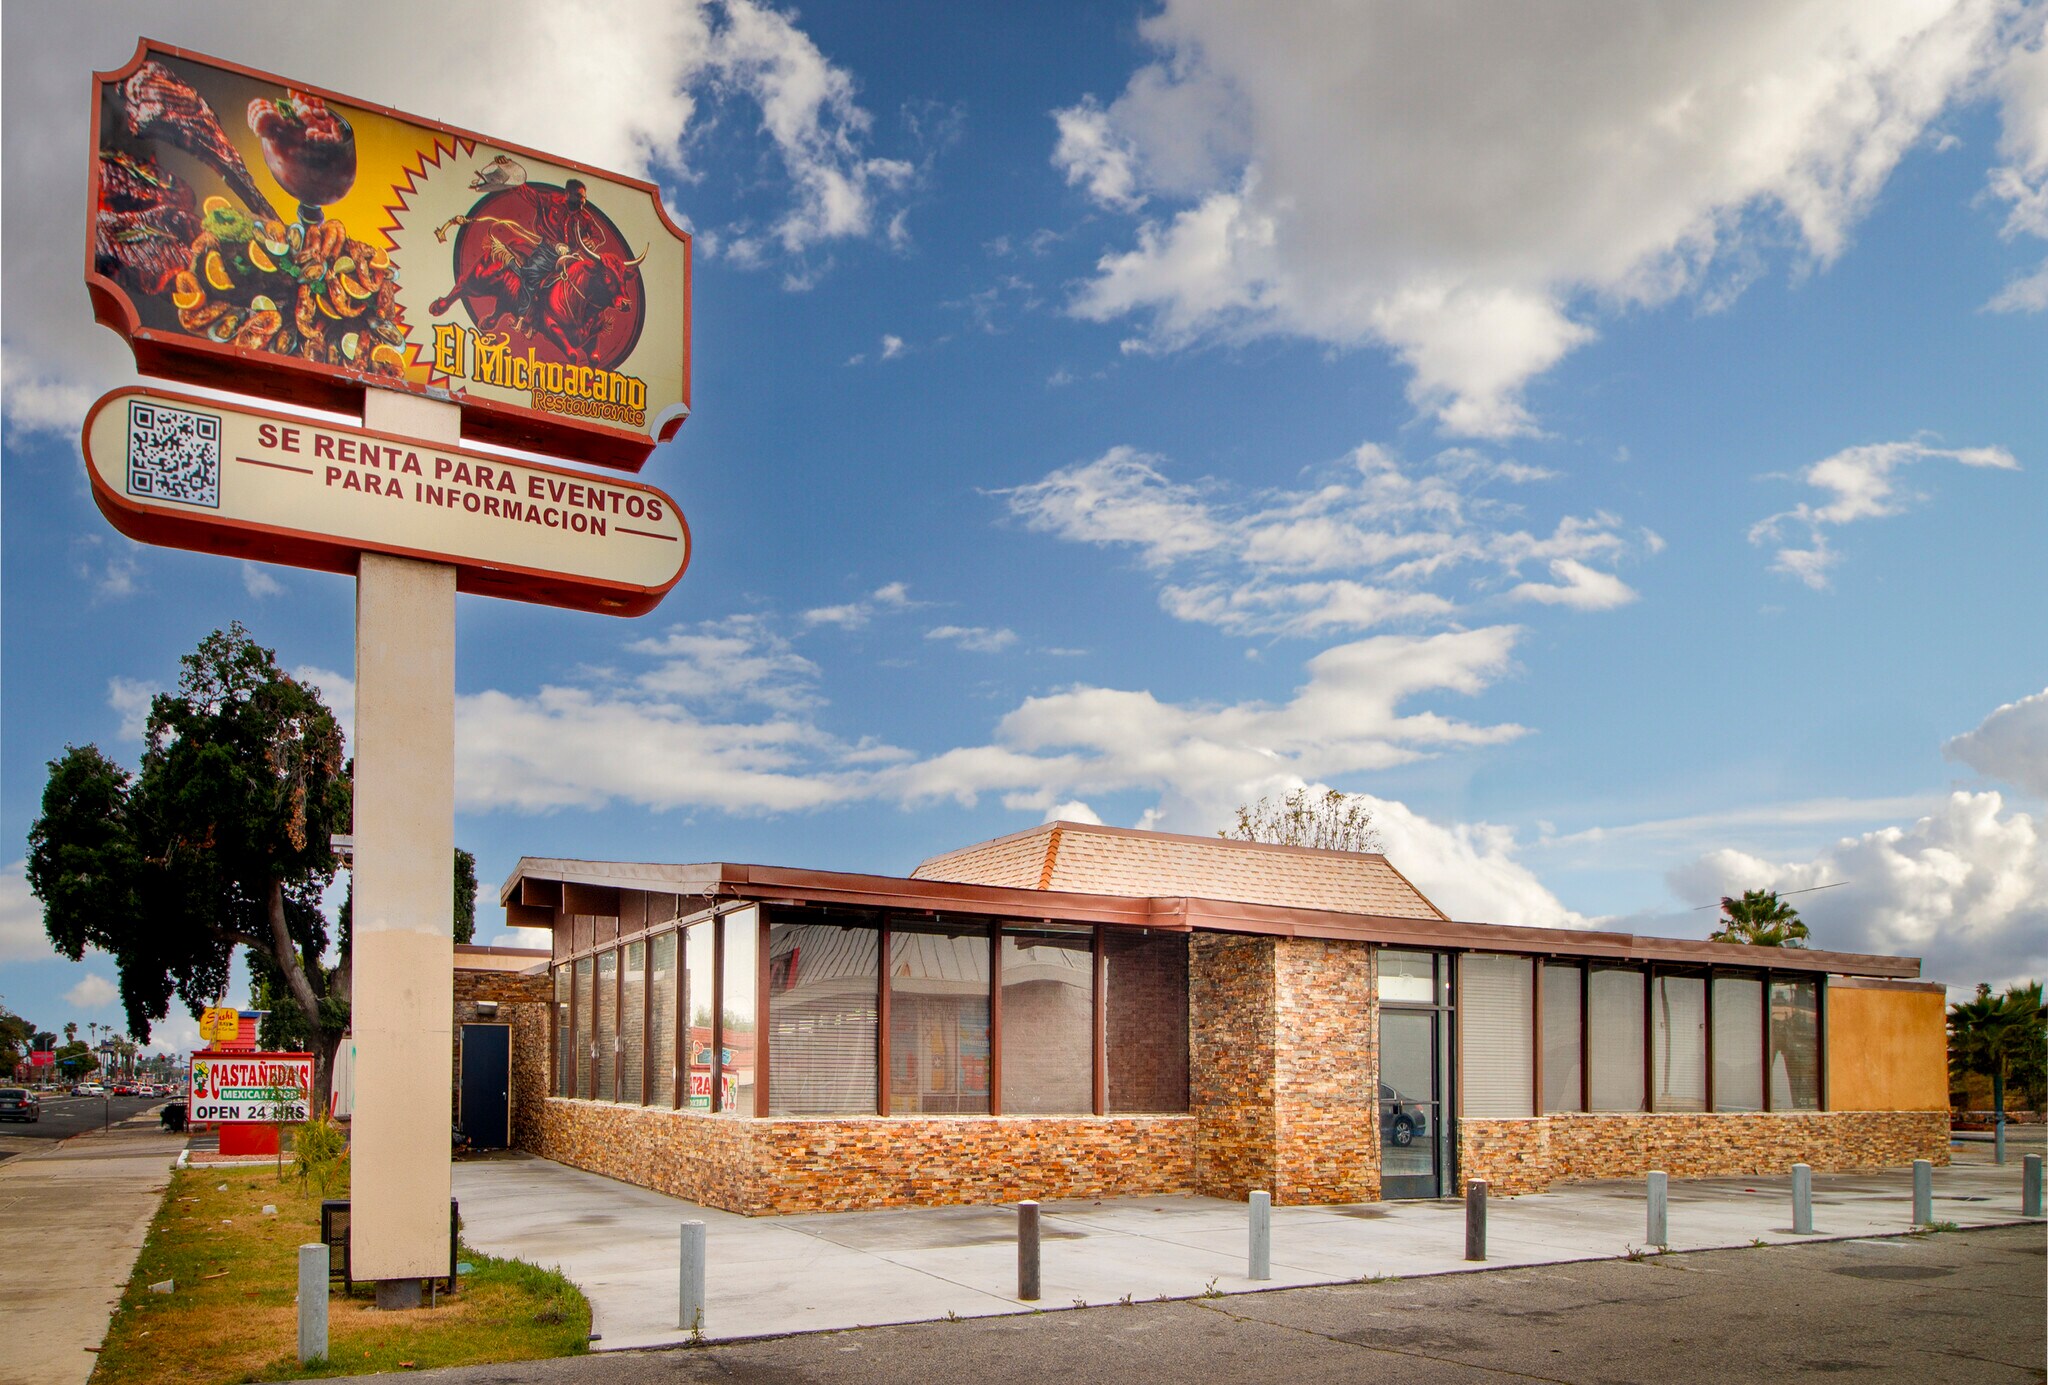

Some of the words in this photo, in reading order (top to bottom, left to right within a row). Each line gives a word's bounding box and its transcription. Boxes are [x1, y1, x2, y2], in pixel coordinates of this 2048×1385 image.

[434, 322, 466, 377] El
[468, 328, 648, 411] Michoacano
[531, 387, 645, 427] Restaurante
[258, 424, 300, 453] SE
[314, 433, 423, 477] RENTA
[434, 457, 517, 495] PARA
[528, 475, 663, 521] EVENTOS
[325, 465, 404, 499] PARA
[415, 482, 607, 537] INFORMACION
[211, 1061, 309, 1100] CASTAÑEDA'S
[222, 1089, 268, 1099] MEXICAN
[196, 1106, 240, 1119] OPEN
[248, 1106, 266, 1119] 24
[273, 1106, 305, 1119] HRS
